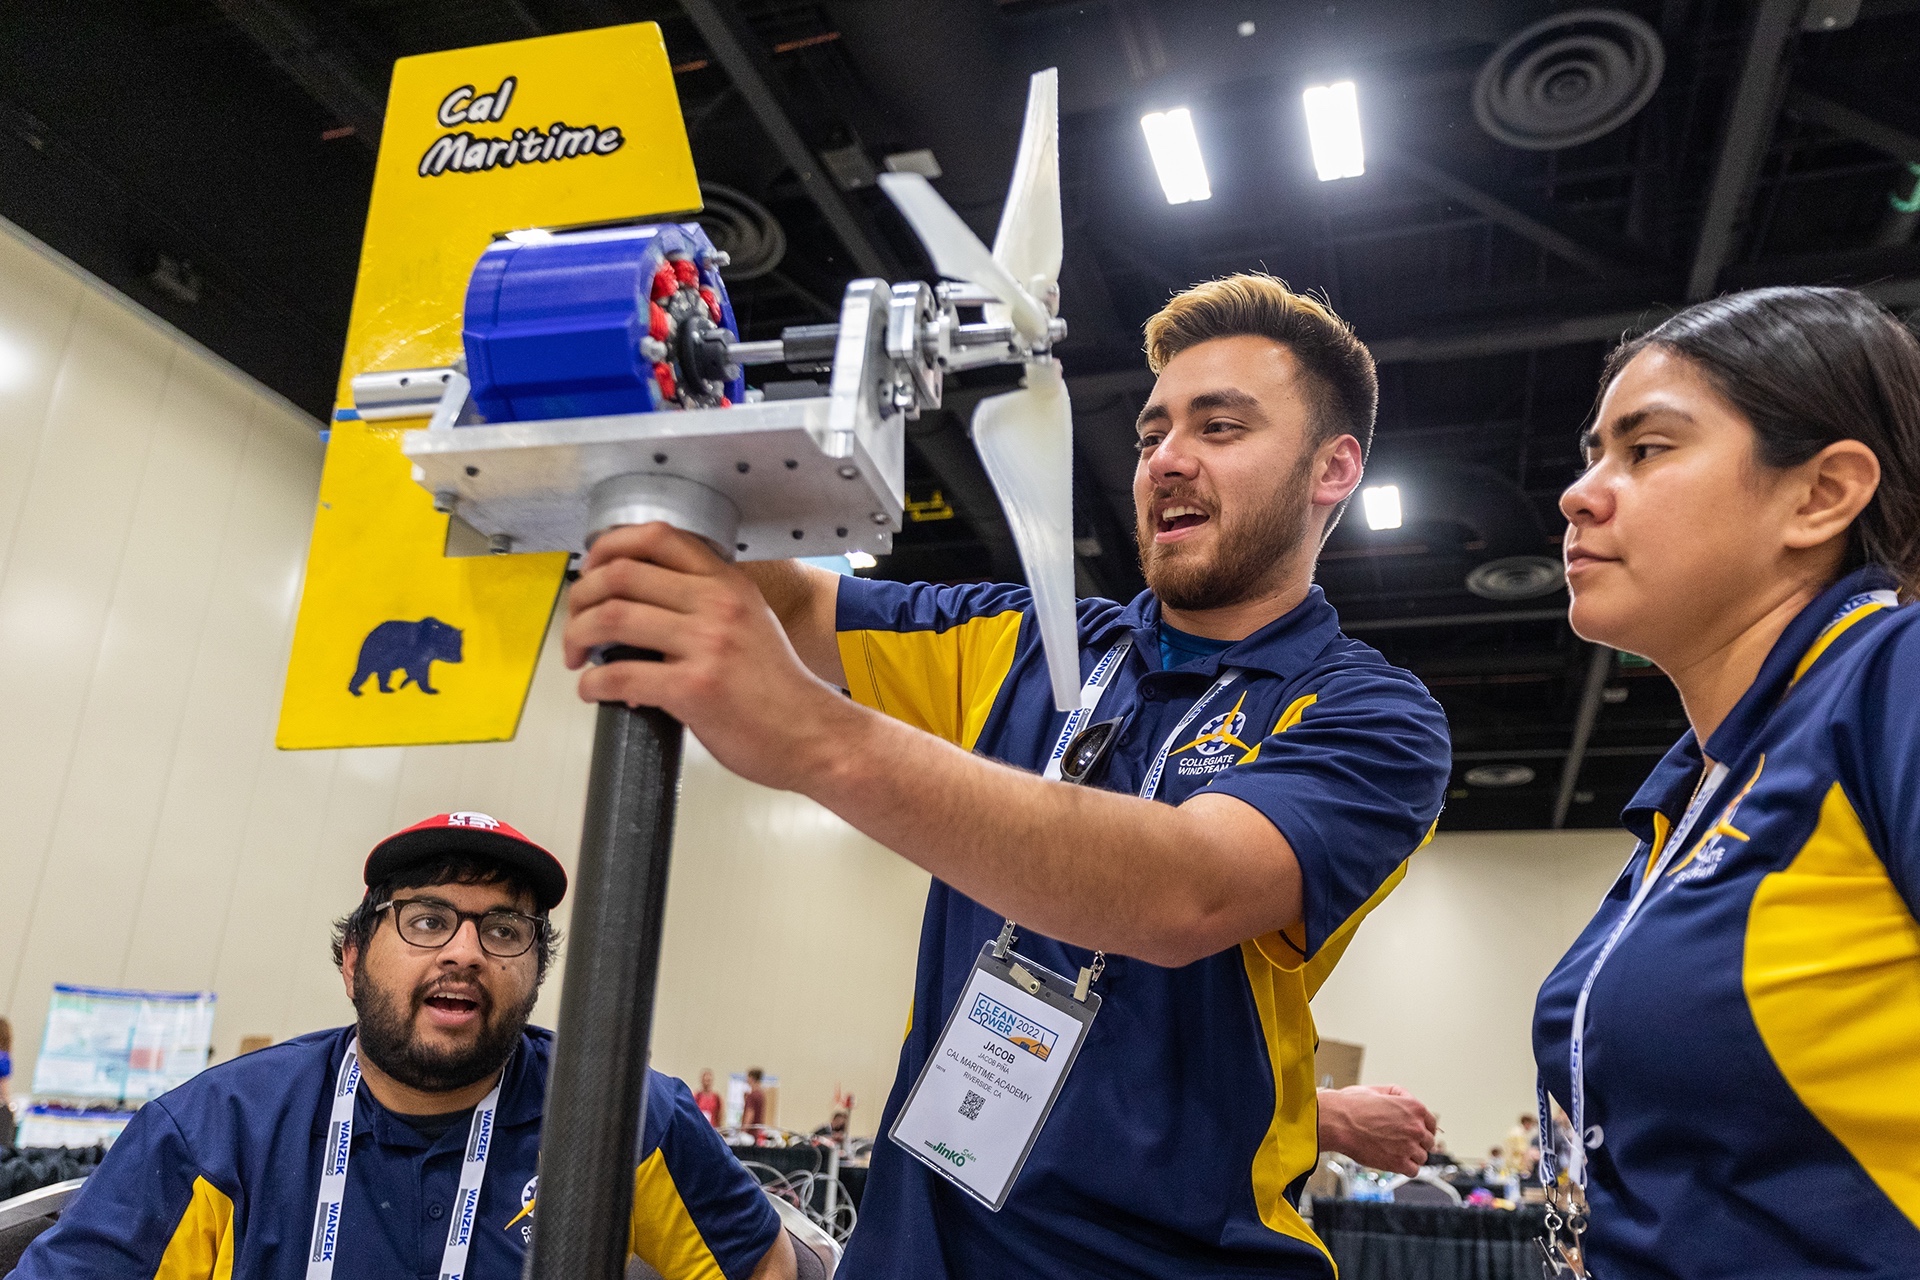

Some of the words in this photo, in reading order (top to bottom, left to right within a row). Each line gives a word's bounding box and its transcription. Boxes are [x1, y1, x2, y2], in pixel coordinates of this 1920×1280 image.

[438, 76, 517, 127] Cal
[419, 122, 625, 177] Maritime
[1088, 645, 1121, 686] WANZEK
[1053, 709, 1082, 759] WANZEK
[1179, 754, 1235, 767] COLLEGIATE
[973, 1008, 1012, 1036] POWER
[978, 999, 1017, 1026] CLEAN
[1016, 1020, 1040, 1039] 2022
[946, 1048, 960, 1062] CAL
[960, 1056, 996, 1082] MARITIME
[994, 1077, 1032, 1103] ACADEMY
[978, 1052, 996, 1067] JACOB
[983, 1041, 1016, 1064] JACOB
[993, 1089, 1002, 1099] CA
[335, 1120, 350, 1175] WANZEK
[477, 1109, 493, 1162] WANZEK
[322, 1202, 340, 1262] WANZEK
[458, 1188, 478, 1246] WANZEK
